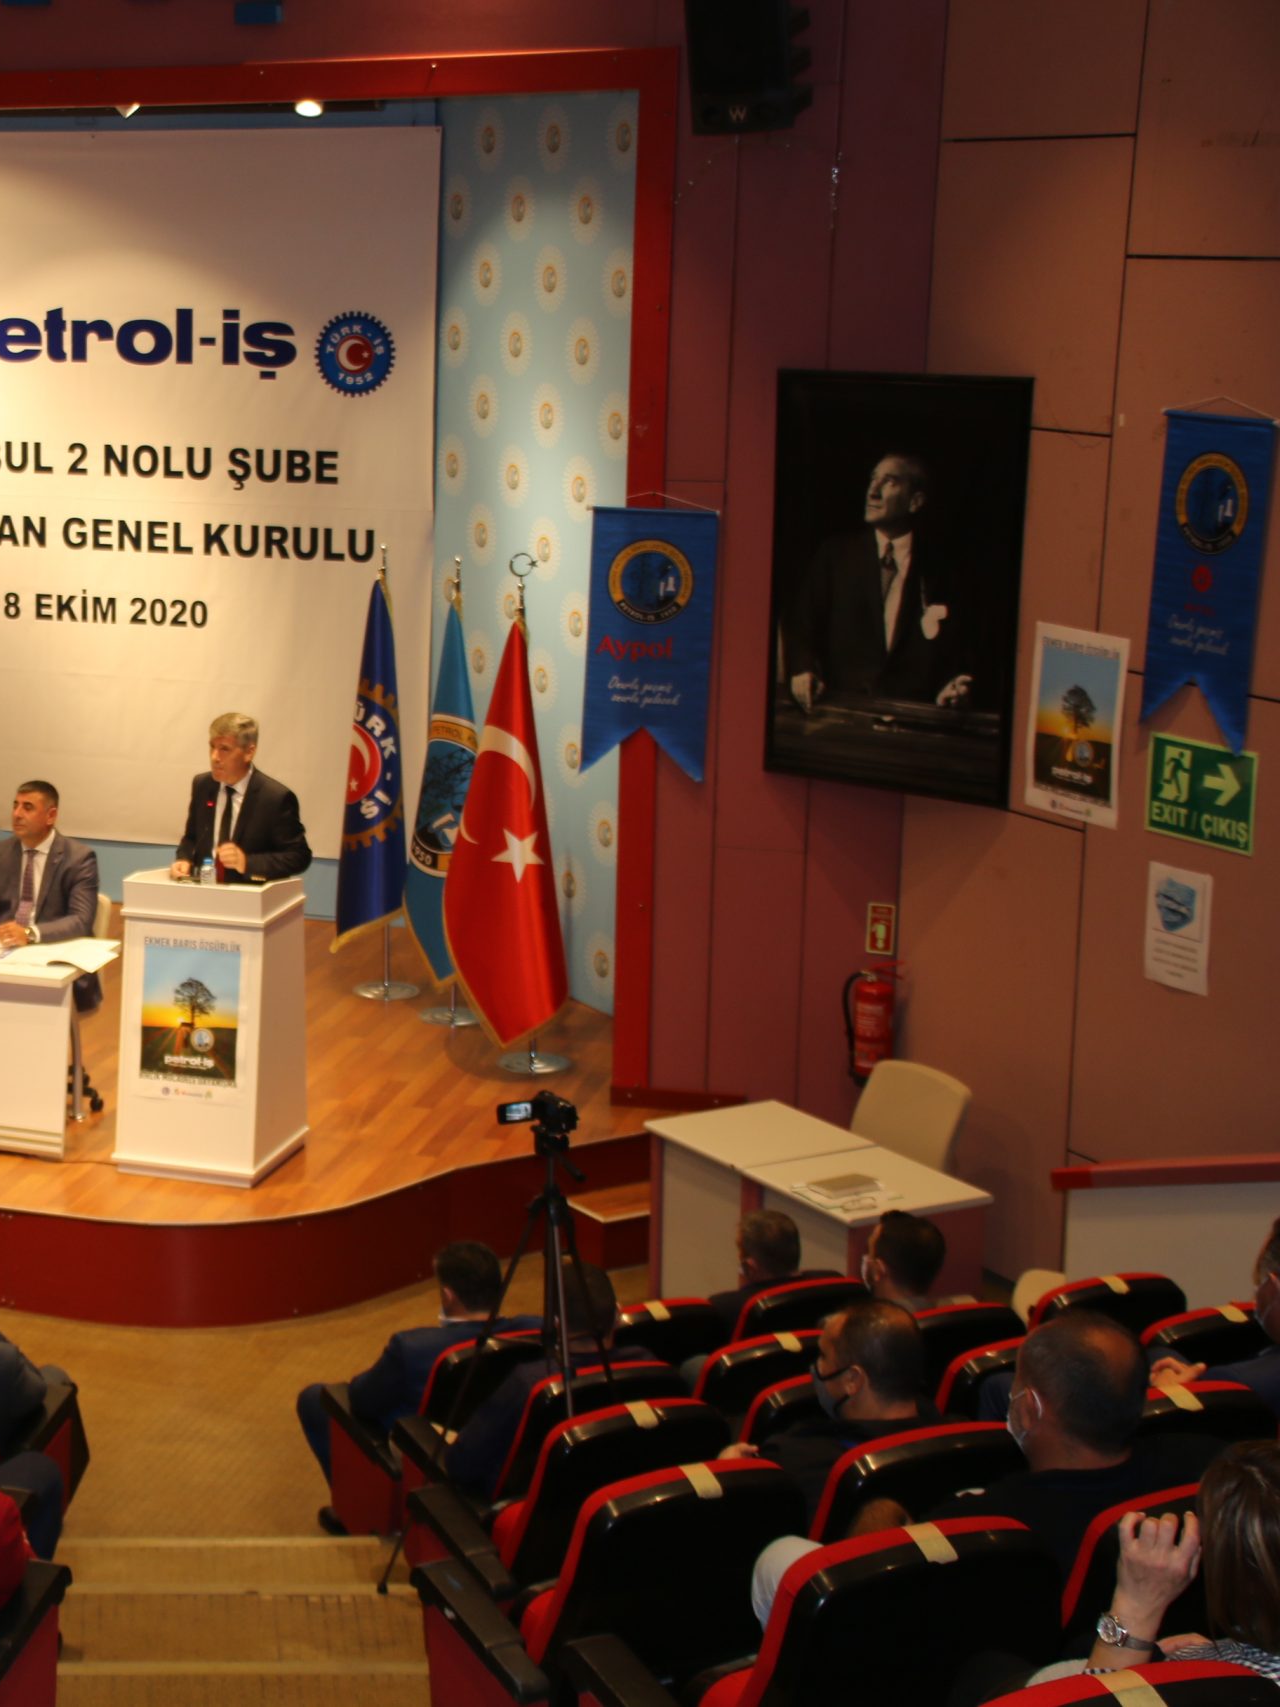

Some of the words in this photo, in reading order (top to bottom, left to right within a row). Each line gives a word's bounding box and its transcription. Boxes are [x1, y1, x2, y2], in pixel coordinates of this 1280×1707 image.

[338, 372, 374, 385] 1952
[67, 442, 88, 475] 2
[103, 443, 212, 481] NOLU
[227, 447, 339, 491] ŞUBE
[61, 517, 194, 556] GENEL
[203, 522, 375, 564] KURULU
[34, 588, 117, 625] EKİM
[129, 597, 209, 629] 2020
[595, 634, 673, 662] Aypol
[1150, 801, 1188, 829] EXIT
[1200, 813, 1248, 849] ÇIKIŞ
